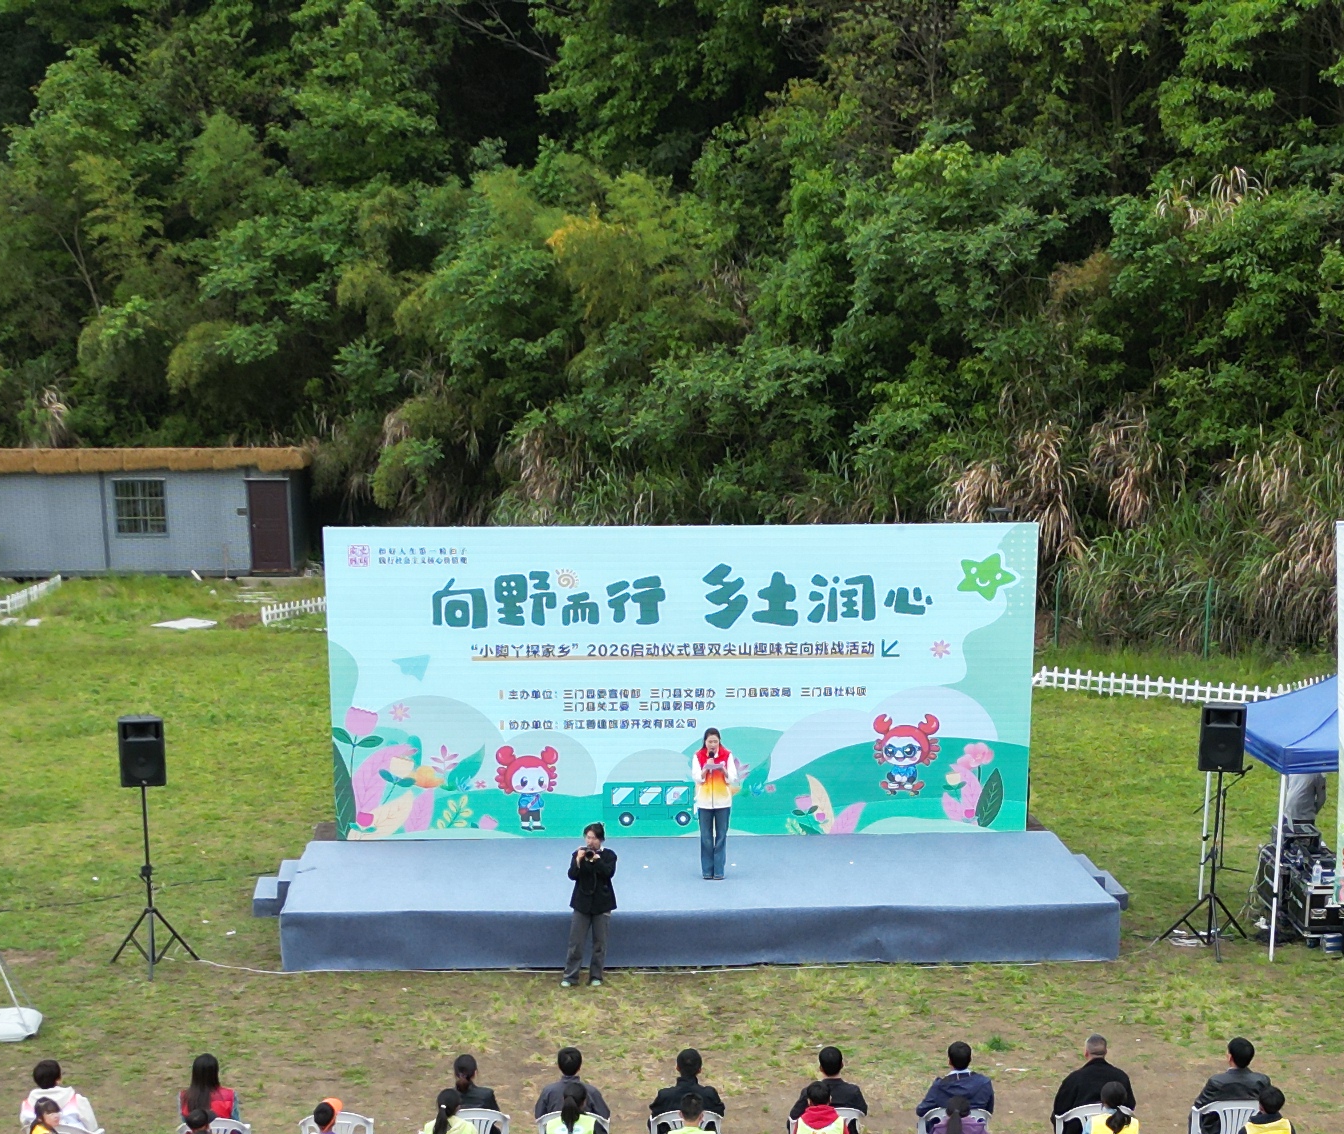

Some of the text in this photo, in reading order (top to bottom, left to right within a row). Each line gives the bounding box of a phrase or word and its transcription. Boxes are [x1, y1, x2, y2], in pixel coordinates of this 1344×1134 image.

[432, 563, 934, 629] 向野而行 乡土润心
